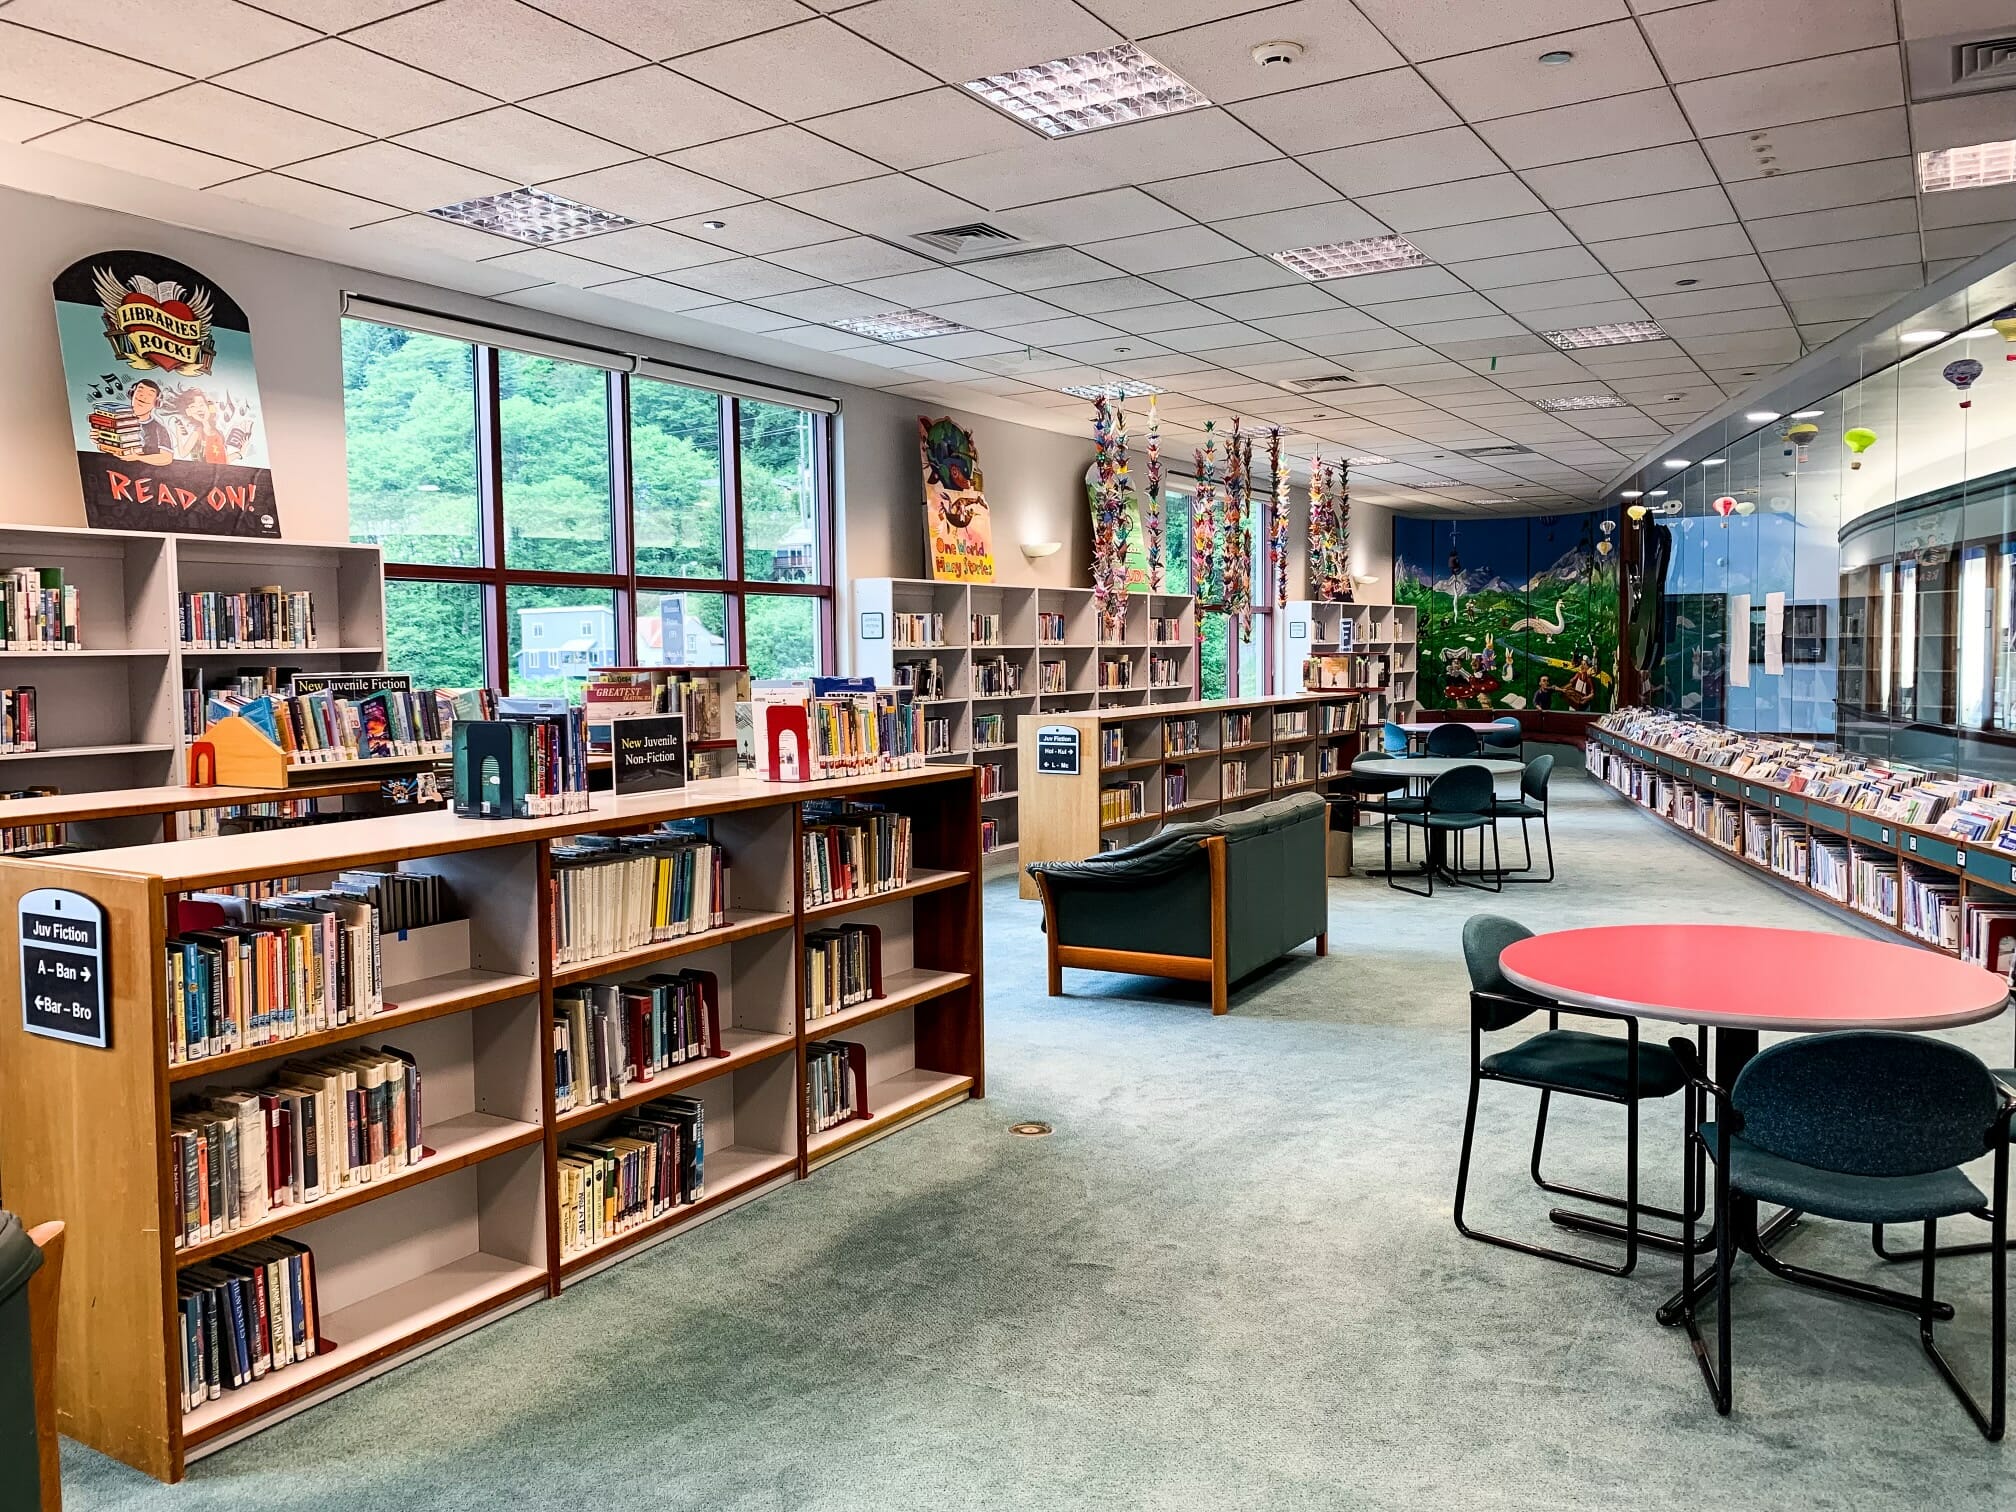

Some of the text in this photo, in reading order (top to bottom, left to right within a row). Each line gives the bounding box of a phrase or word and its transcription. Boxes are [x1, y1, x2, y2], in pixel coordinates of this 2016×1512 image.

[120, 306, 199, 337] LIBRARIES
[138, 333, 192, 360] ROCK!
[106, 470, 256, 512] READ ON!
[936, 537, 956, 555] One
[936, 556, 992, 578] Many Stories
[299, 678, 406, 692] New Juvenile Fiction
[596, 687, 642, 697] GREATEST
[622, 735, 677, 749] New Juvenile
[625, 751, 675, 766] Non-Fiction
[33, 921, 88, 943] Juv Fiction
[38, 960, 46, 975] A
[56, 963, 76, 980] Ban
[44, 997, 62, 1014] Bar
[72, 1003, 91, 1020] Bro
